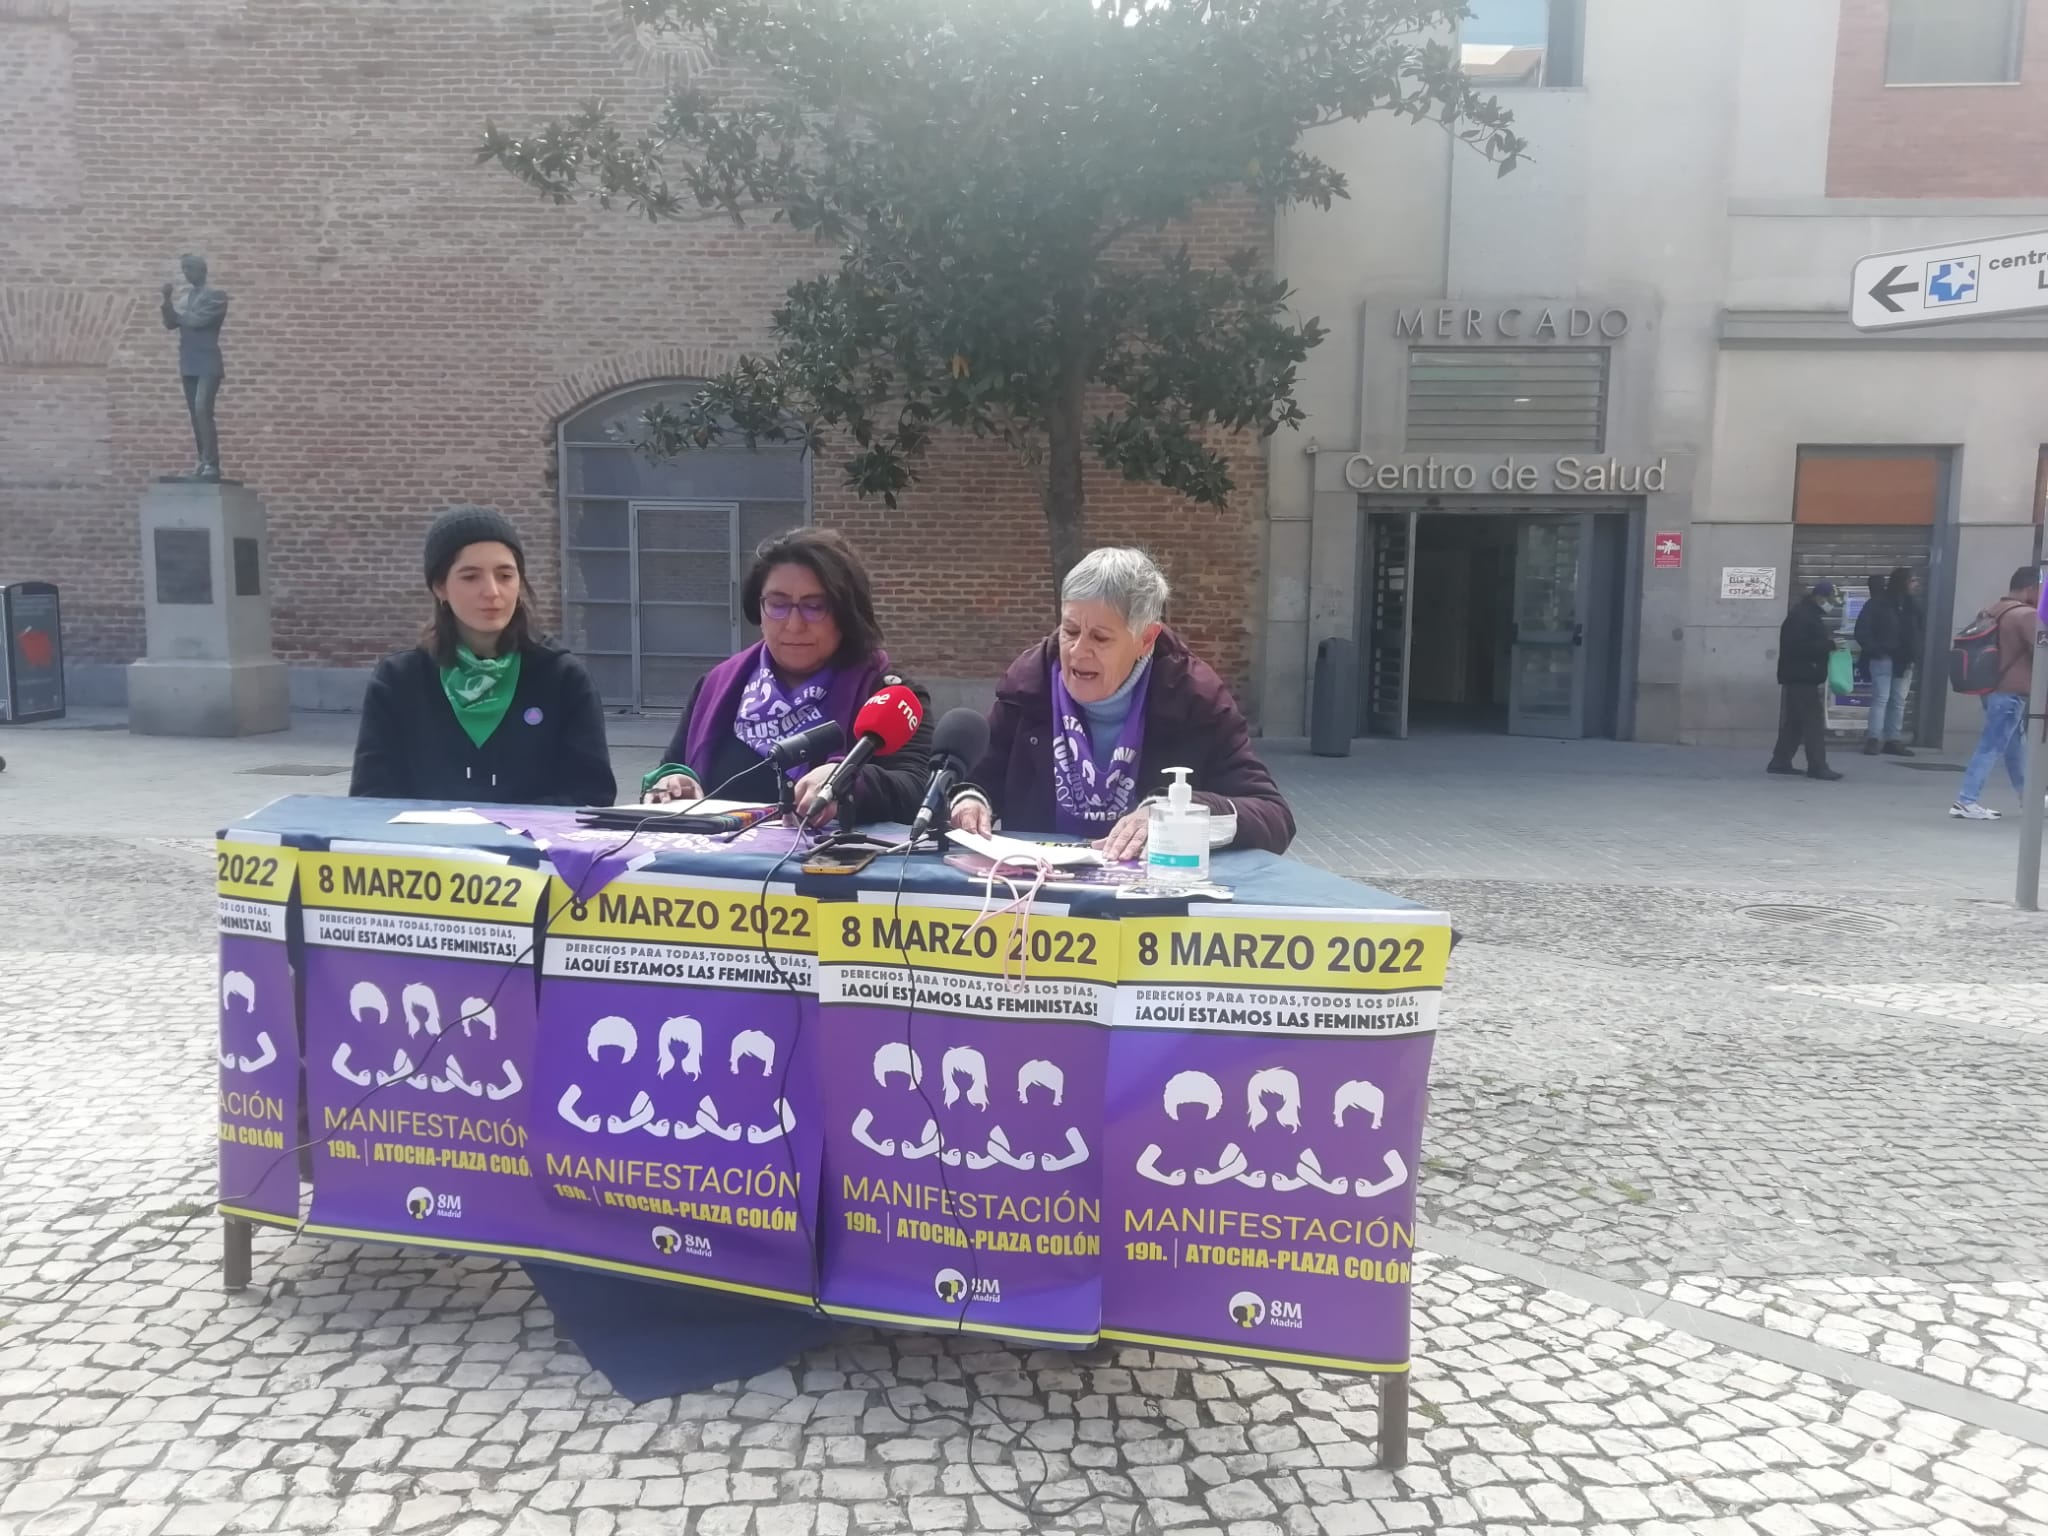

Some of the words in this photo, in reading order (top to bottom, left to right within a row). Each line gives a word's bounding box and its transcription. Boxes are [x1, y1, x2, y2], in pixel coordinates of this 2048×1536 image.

[1989, 250, 2048, 270] centr
[1396, 307, 1629, 337] MERCADO
[1345, 454, 1477, 490] Centro
[1491, 457, 1539, 490] de
[1554, 456, 1667, 491] Salud
[897, 699, 918, 731] rne
[218, 852, 278, 887] 2022
[318, 864, 334, 893] 8
[343, 866, 441, 901] MARZO
[450, 873, 522, 908] 2022
[231, 904, 245, 913] LOS
[570, 896, 588, 922] 8
[599, 893, 720, 930] MARZO
[729, 903, 811, 937] 2022
[319, 913, 367, 925] DERECHOS
[370, 917, 395, 928] PARA
[469, 926, 486, 936] LOS
[319, 927, 356, 942] ¡AQUÍ
[358, 930, 413, 947] ESTAMOS
[416, 935, 437, 949] LAS
[441, 938, 516, 957] FEMINISTAS!
[566, 943, 627, 956] DERECHOS
[630, 946, 661, 958] PARA
[754, 953, 777, 965] LOS
[841, 916, 861, 948] 8
[872, 917, 997, 959] MARZO
[1008, 928, 1097, 965] 2022
[1138, 932, 1159, 966] 8
[1170, 931, 1315, 971] MARZO
[1327, 936, 1425, 973] 2022
[565, 956, 611, 973] ¡AQUÍ
[613, 960, 684, 978] ESTAMOS
[688, 964, 715, 981] LAS
[718, 967, 812, 987] FEMINISTAS!
[840, 969, 904, 982] DERECHOS
[907, 973, 939, 986] PARA
[1035, 983, 1059, 995] LOS
[842, 983, 890, 999] ¡AQUÍ
[893, 987, 962, 1007] ESTAMOS
[965, 992, 994, 1011] LAS
[997, 997, 1098, 1017] FEMINISTAS!
[1136, 989, 1202, 1002] DERECHOS
[1206, 991, 1244, 1004] PARA
[1356, 996, 1382, 1009] LOS
[1136, 1004, 1185, 1022] ¡AQUÍ
[1189, 1007, 1272, 1026] ESTAMOS
[1277, 1011, 1310, 1028] LAS
[1314, 1011, 1419, 1030] FEMINISTAS!
[239, 1126, 283, 1149] COLÓN
[327, 1139, 361, 1159] 19h.
[374, 1143, 487, 1172] ATOCHA-PLAZA
[489, 1154, 533, 1178] COLÓ
[546, 1153, 800, 1199] MANIFESTACIÓN
[436, 1208, 462, 1219] Madrid
[437, 1193, 462, 1210] 8M
[553, 1183, 592, 1201] 19h.
[604, 1191, 733, 1225] ATOCHA-PLAZA
[736, 1206, 798, 1232] COLÓN
[843, 1174, 1100, 1224] MANIFESTACIÓN
[684, 1234, 712, 1250] 8M
[844, 1211, 882, 1235] 19h.
[896, 1218, 1032, 1253] ATOCHA-PLAZA
[1036, 1231, 1100, 1256] COLÓN
[1125, 1206, 1415, 1249] MANIFESTACIÓN
[685, 1246, 713, 1258] Madrid
[1124, 1242, 1168, 1262] 19h.
[1185, 1244, 1339, 1276] ATOCHA-PLAZA
[1344, 1256, 1411, 1284] COLÓN
[971, 1278, 1000, 1294] 8M
[971, 1293, 1001, 1303] Madrid
[1270, 1300, 1303, 1319] 8M
[1270, 1317, 1303, 1329] Madrid
